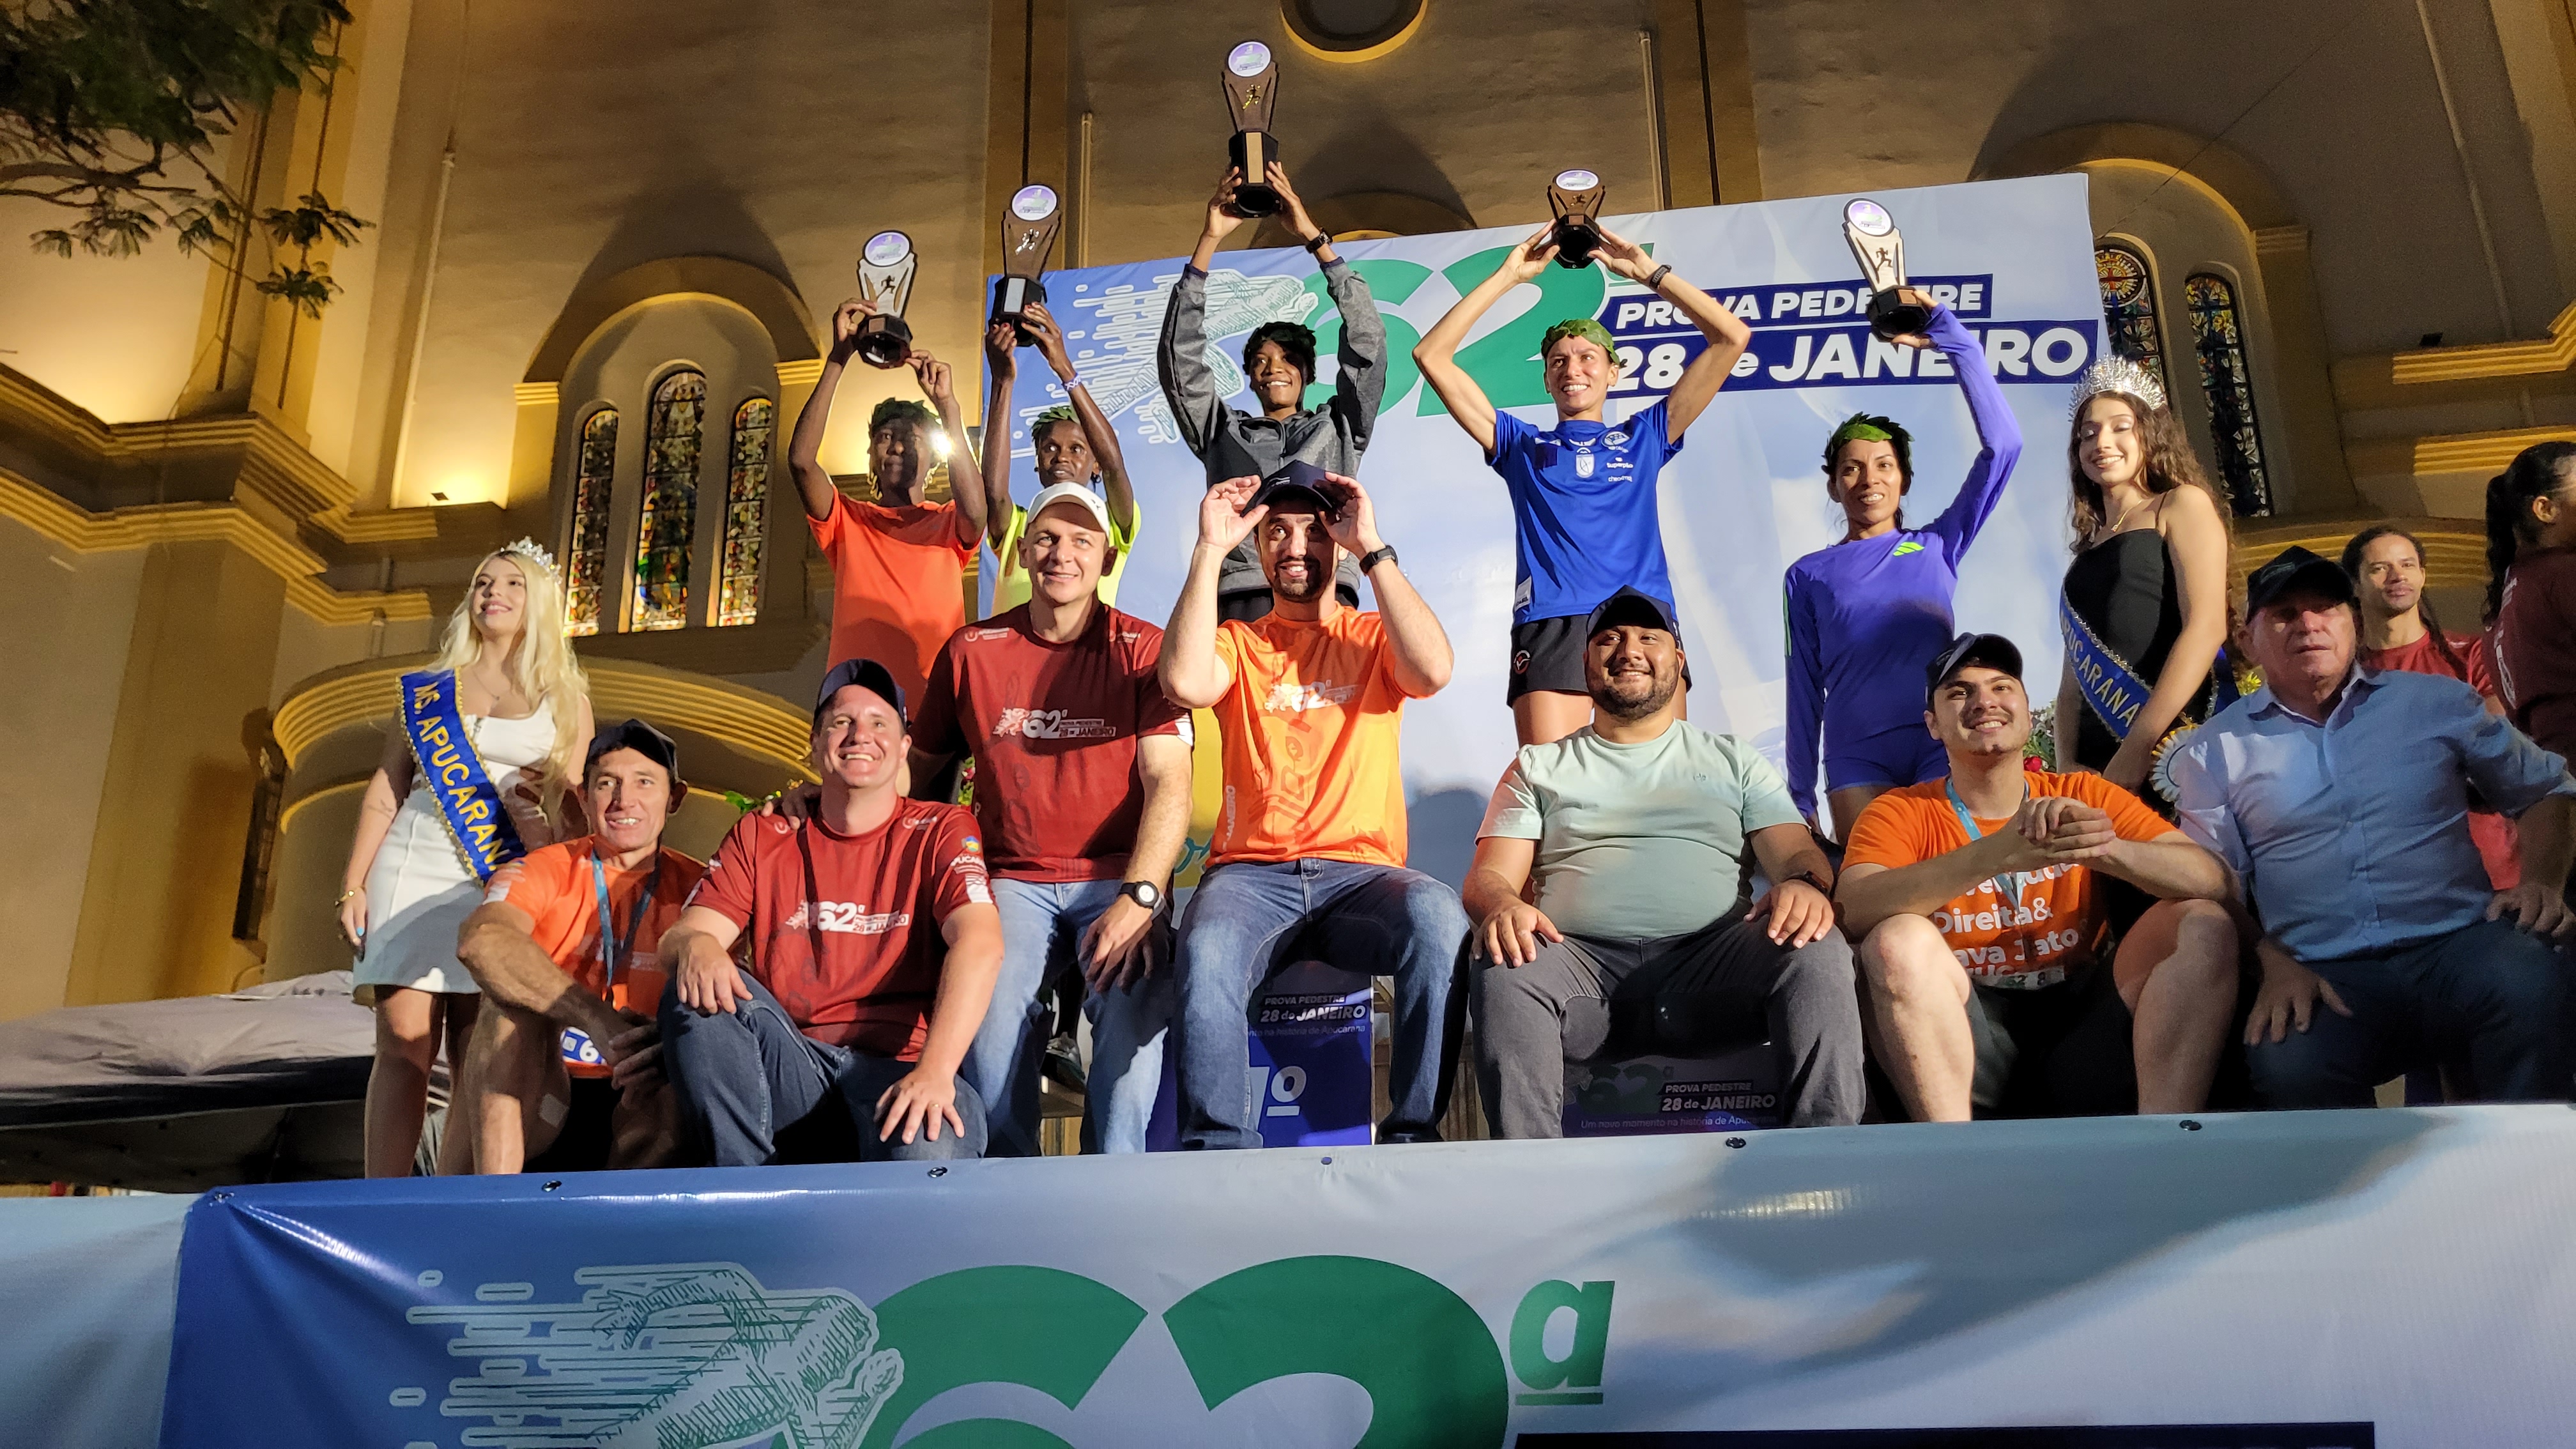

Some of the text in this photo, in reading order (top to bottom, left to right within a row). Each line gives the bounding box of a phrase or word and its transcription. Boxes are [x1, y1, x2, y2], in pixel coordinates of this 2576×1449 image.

[1770, 283, 1984, 319] PEDERE
[1302, 241, 1655, 417] 62
[1606, 327, 2089, 392] 28 e JANERO
[417, 715, 510, 871] APUCARAN
[1953, 946, 2006, 967] ava
[1260, 1009, 1280, 1023] 28
[1296, 1005, 1367, 1022] JANEIRO
[1665, 1084, 1700, 1093] PROVA
[1661, 1094, 1776, 1112] 28 de JANEIRO
[1715, 1116, 1727, 1125] de
